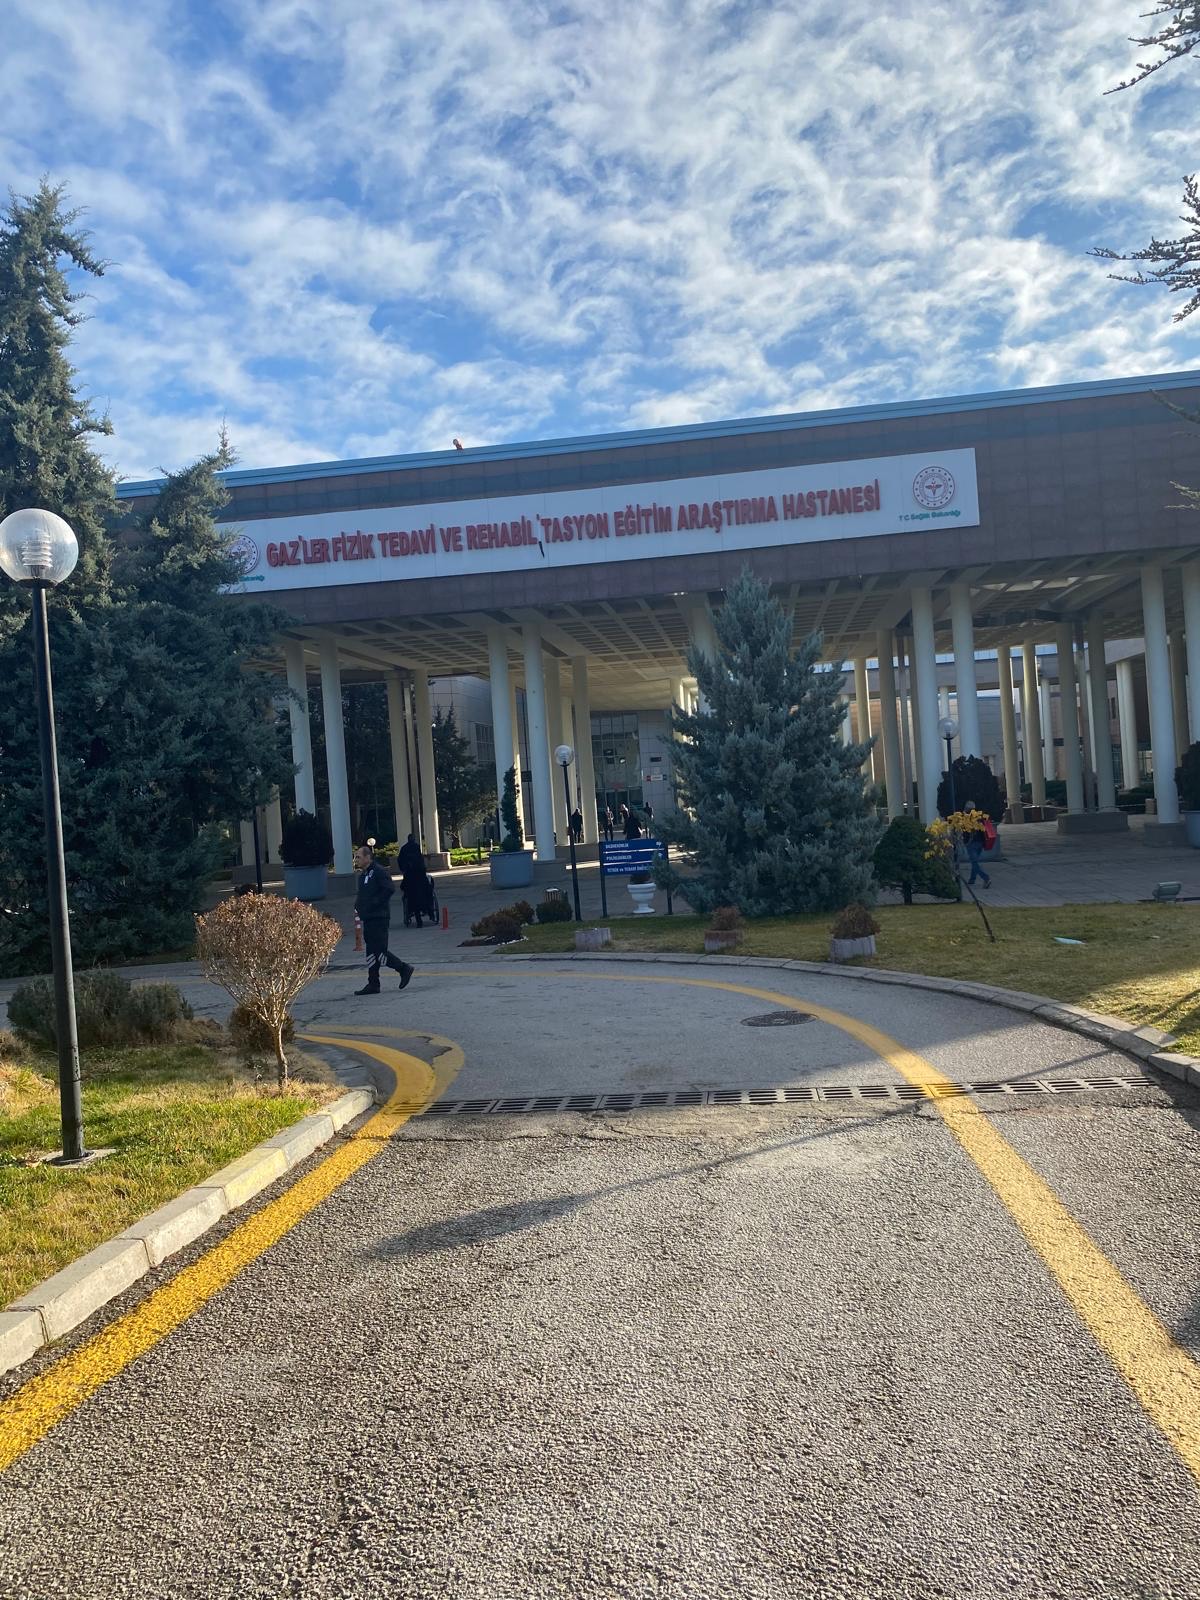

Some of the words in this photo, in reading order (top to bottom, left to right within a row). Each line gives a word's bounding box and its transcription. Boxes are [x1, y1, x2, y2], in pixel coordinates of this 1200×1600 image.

[332, 530, 375, 562] FİZİK
[377, 523, 436, 558] TEDAVİ
[439, 526, 463, 552] VE
[466, 512, 610, 550] REHABİLTASYON
[613, 499, 671, 537] EĞİTİM
[677, 495, 778, 534] ARAŞTIRMA
[782, 478, 881, 521] HASTANESİ
